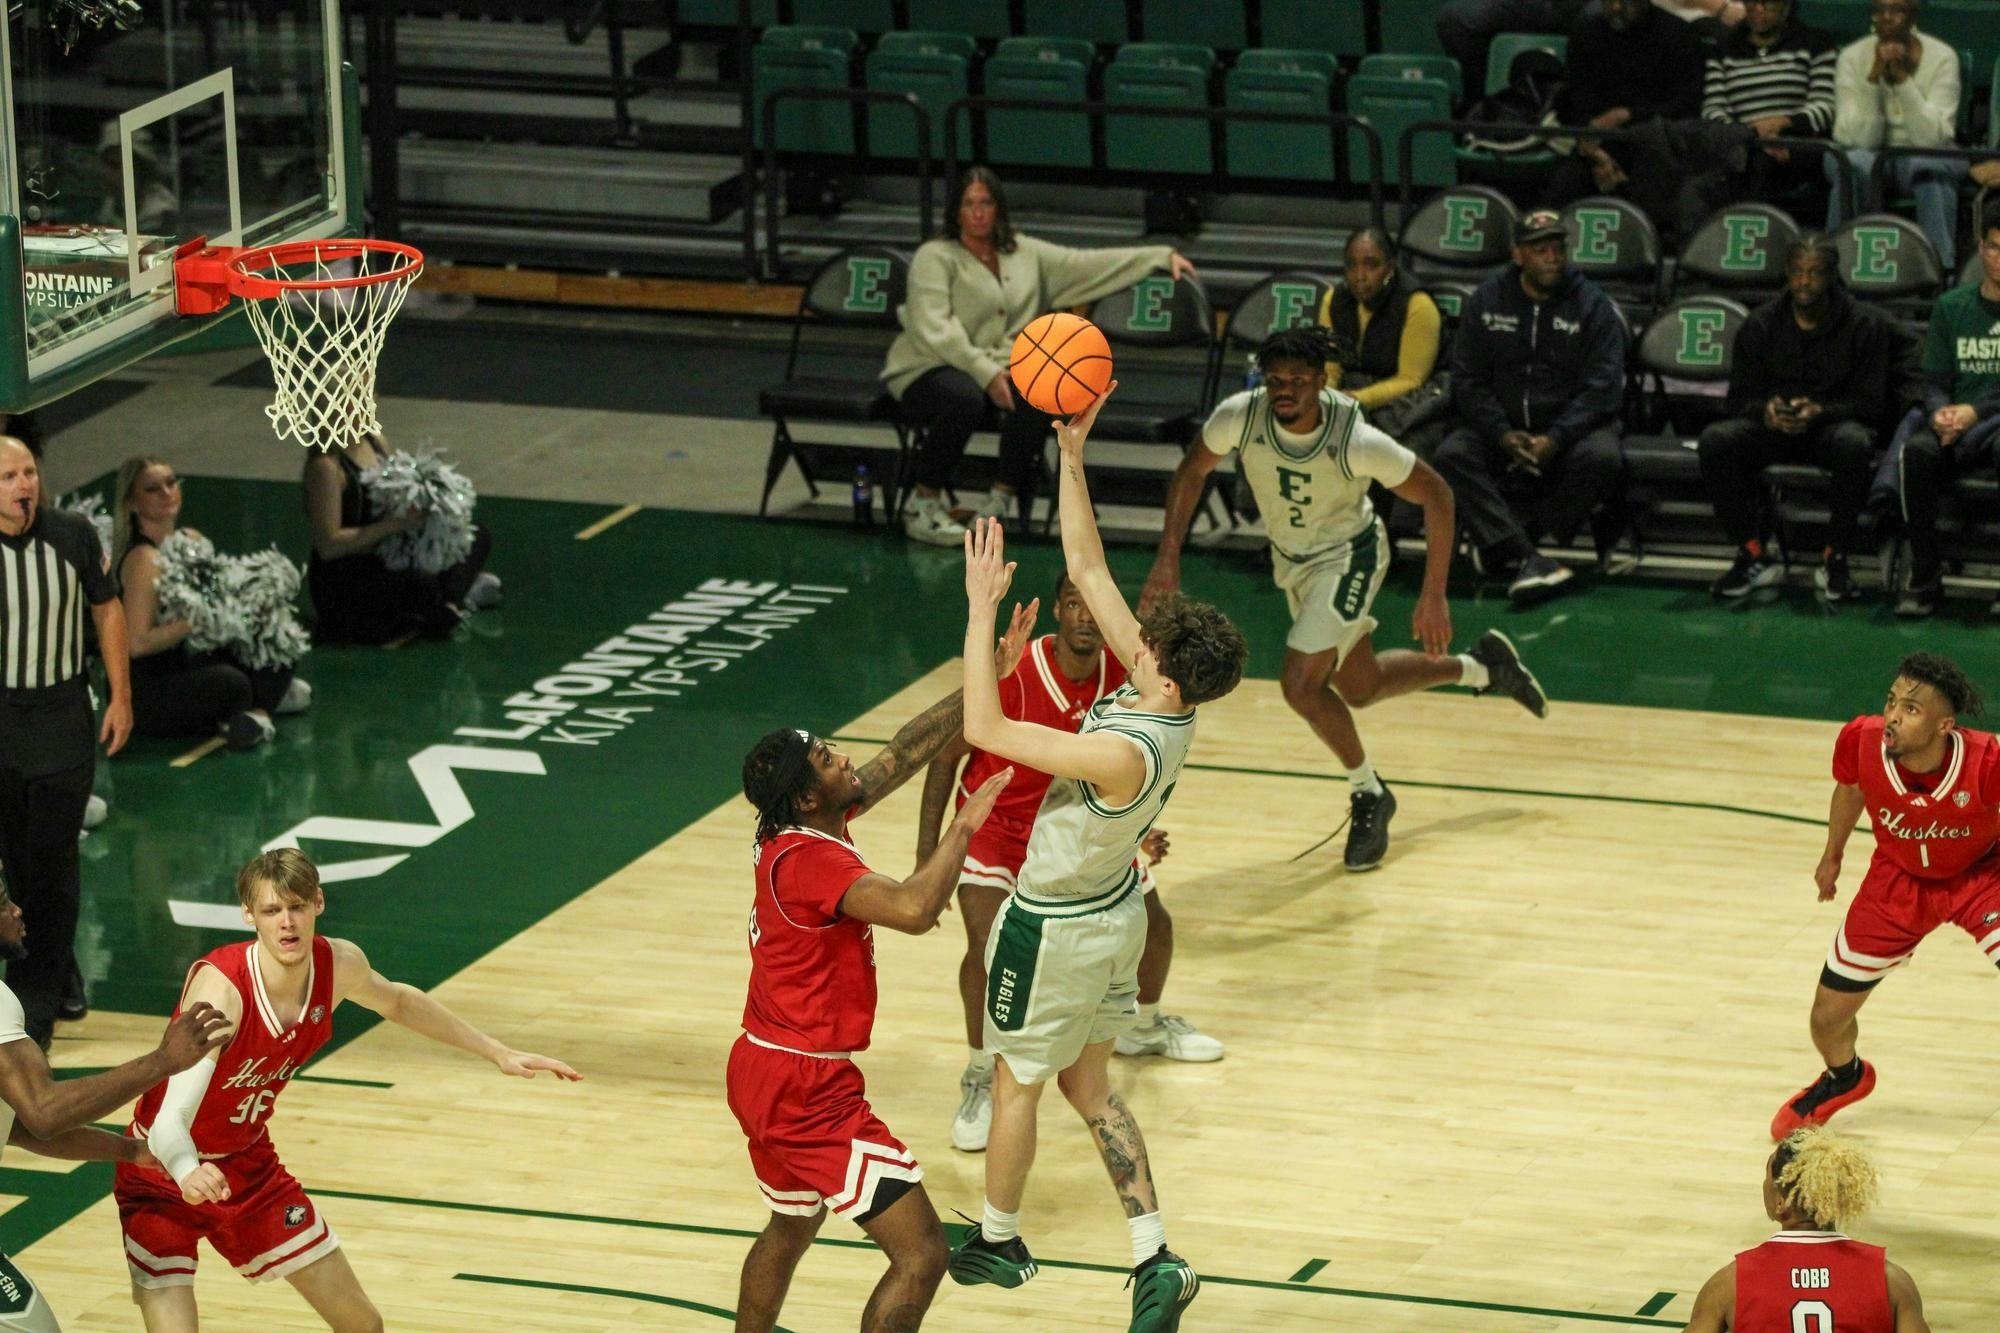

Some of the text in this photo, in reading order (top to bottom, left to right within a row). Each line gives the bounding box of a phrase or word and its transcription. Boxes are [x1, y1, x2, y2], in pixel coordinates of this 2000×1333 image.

[1440, 196, 1488, 251] E
[1573, 208, 1620, 263] E
[1721, 214, 1769, 270] E
[1851, 227, 1899, 282] E
[26, 272, 113, 294] ONTAINE
[843, 256, 891, 312] E
[1127, 276, 1175, 332] E
[1676, 308, 1725, 365] E
[1957, 337, 2000, 359] EAST
[1276, 466, 1312, 506] E
[1289, 507, 1306, 528] 2
[453, 578, 779, 740] LAFONTAINE
[539, 584, 849, 746] KIA YPSILANTI
[1879, 807, 1971, 840] Huskies
[1920, 843, 1930, 869] 1
[995, 967, 1018, 1023] EAGLES
[1791, 1267, 1830, 1289] COBB
